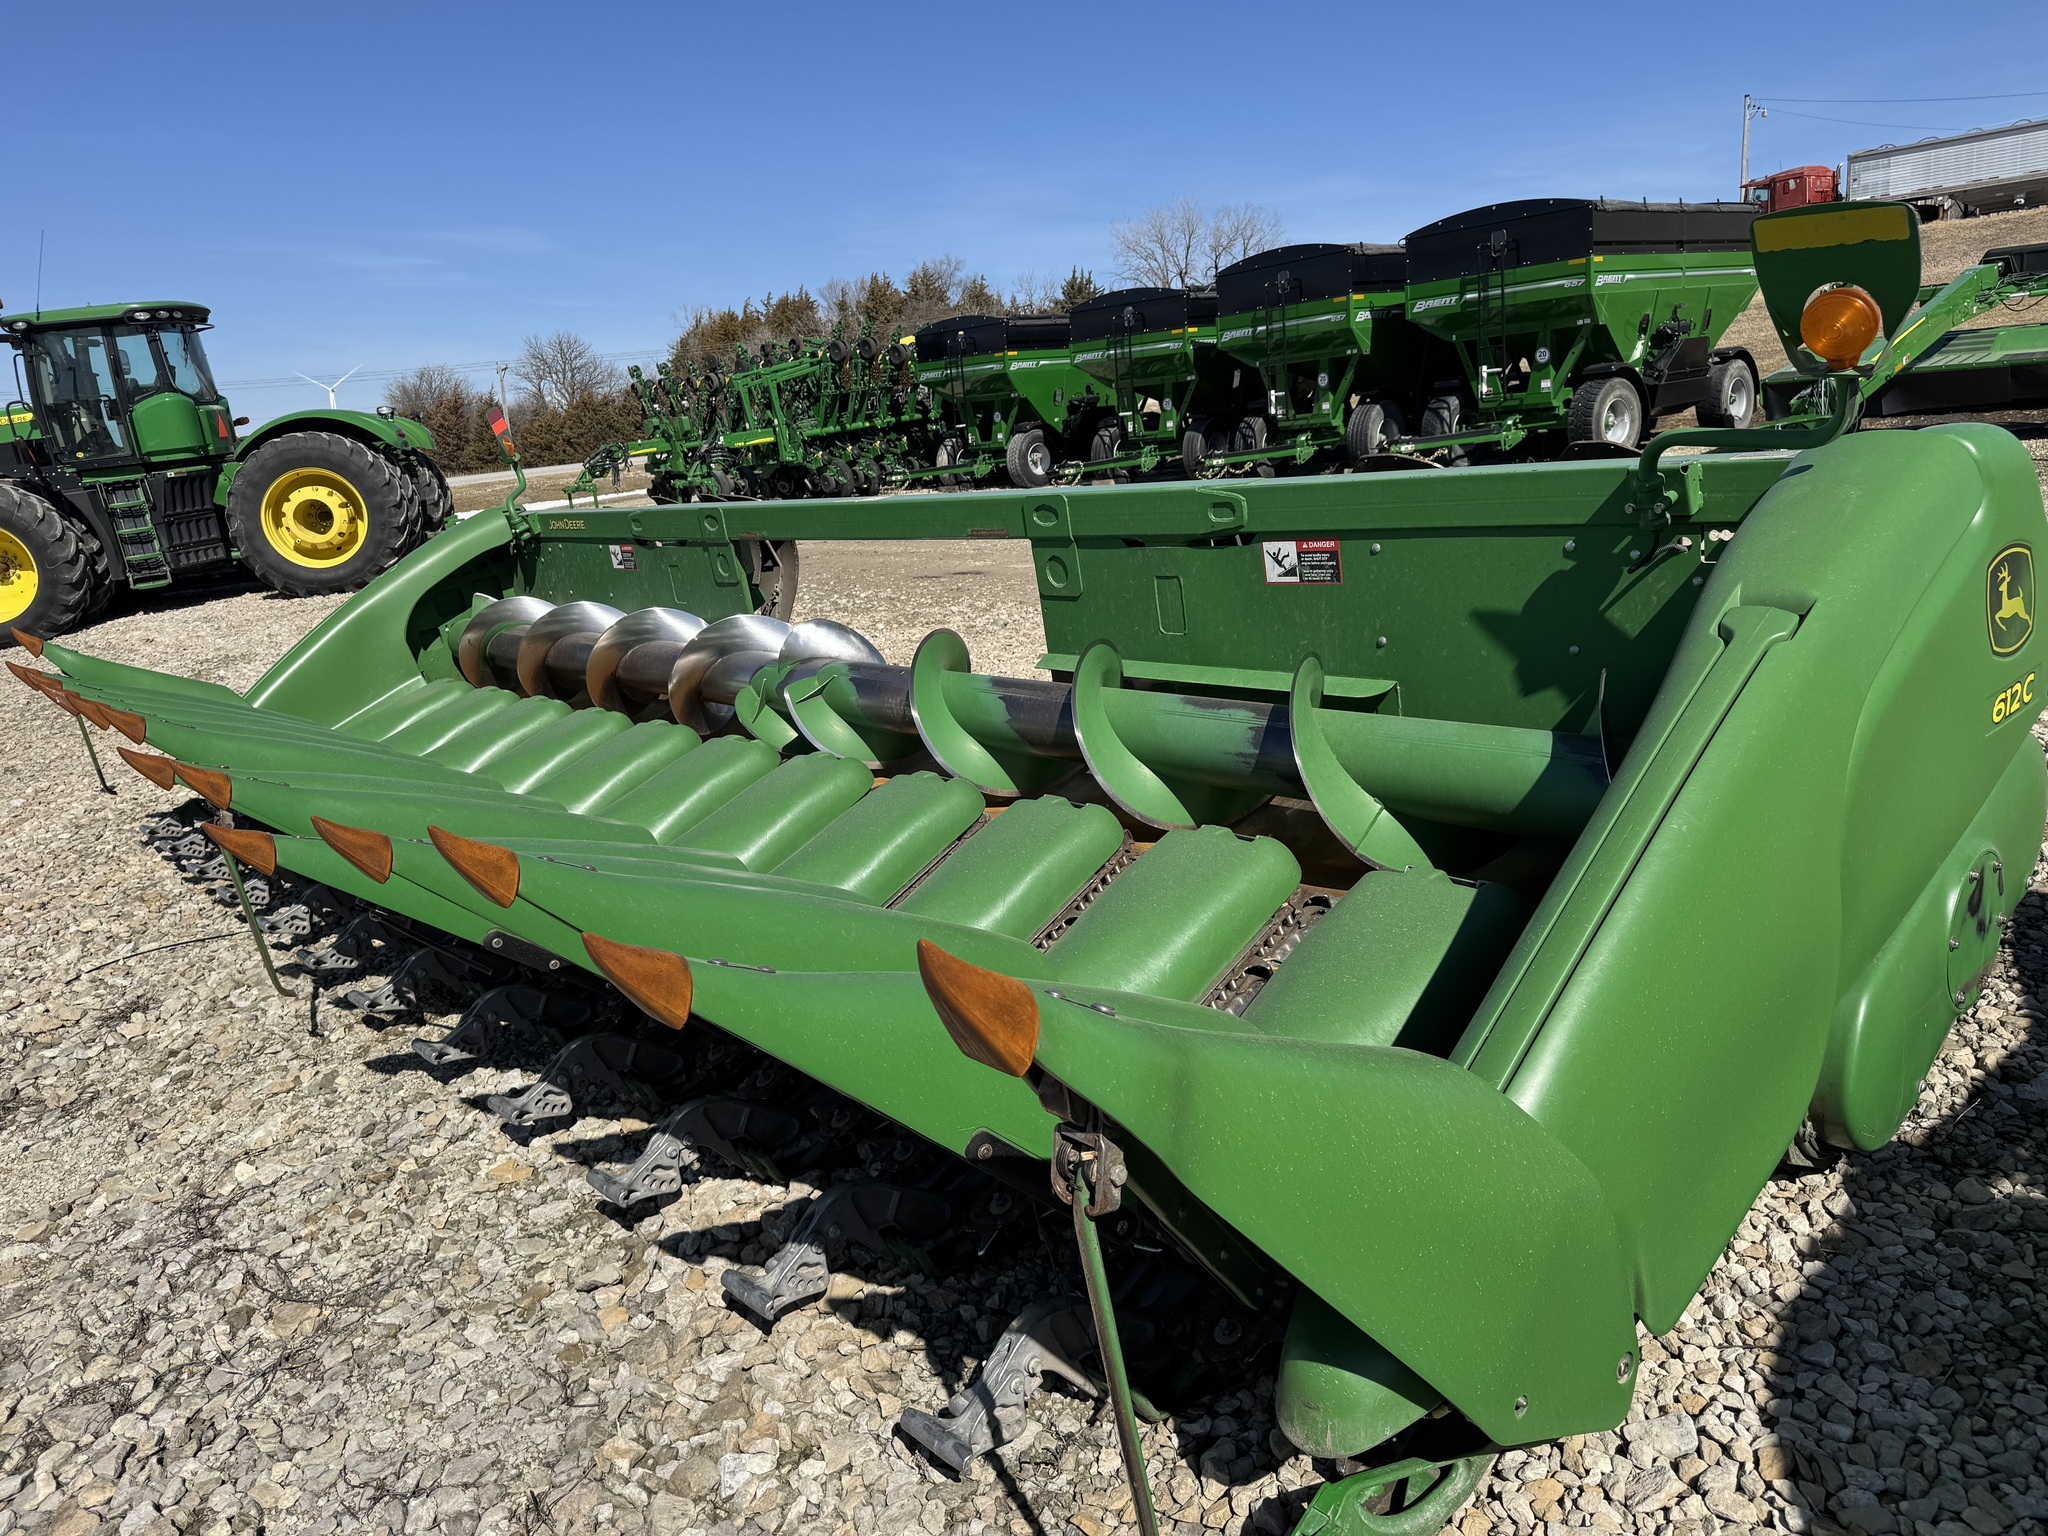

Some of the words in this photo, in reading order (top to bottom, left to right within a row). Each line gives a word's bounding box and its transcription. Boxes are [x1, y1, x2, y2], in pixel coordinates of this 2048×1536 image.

[1563, 278, 1586, 290] 657
[1595, 275, 1623, 287] BRENT
[1412, 295, 1460, 313] BRENT
[1221, 327, 1254, 342] BRENT
[1073, 351, 1104, 364] BRENT
[1538, 350, 1547, 358] 20
[1009, 361, 1038, 371] BRENT
[919, 371, 943, 381] BRENT
[564, 519, 586, 530] DEERE
[1992, 671, 2035, 724] 612C
